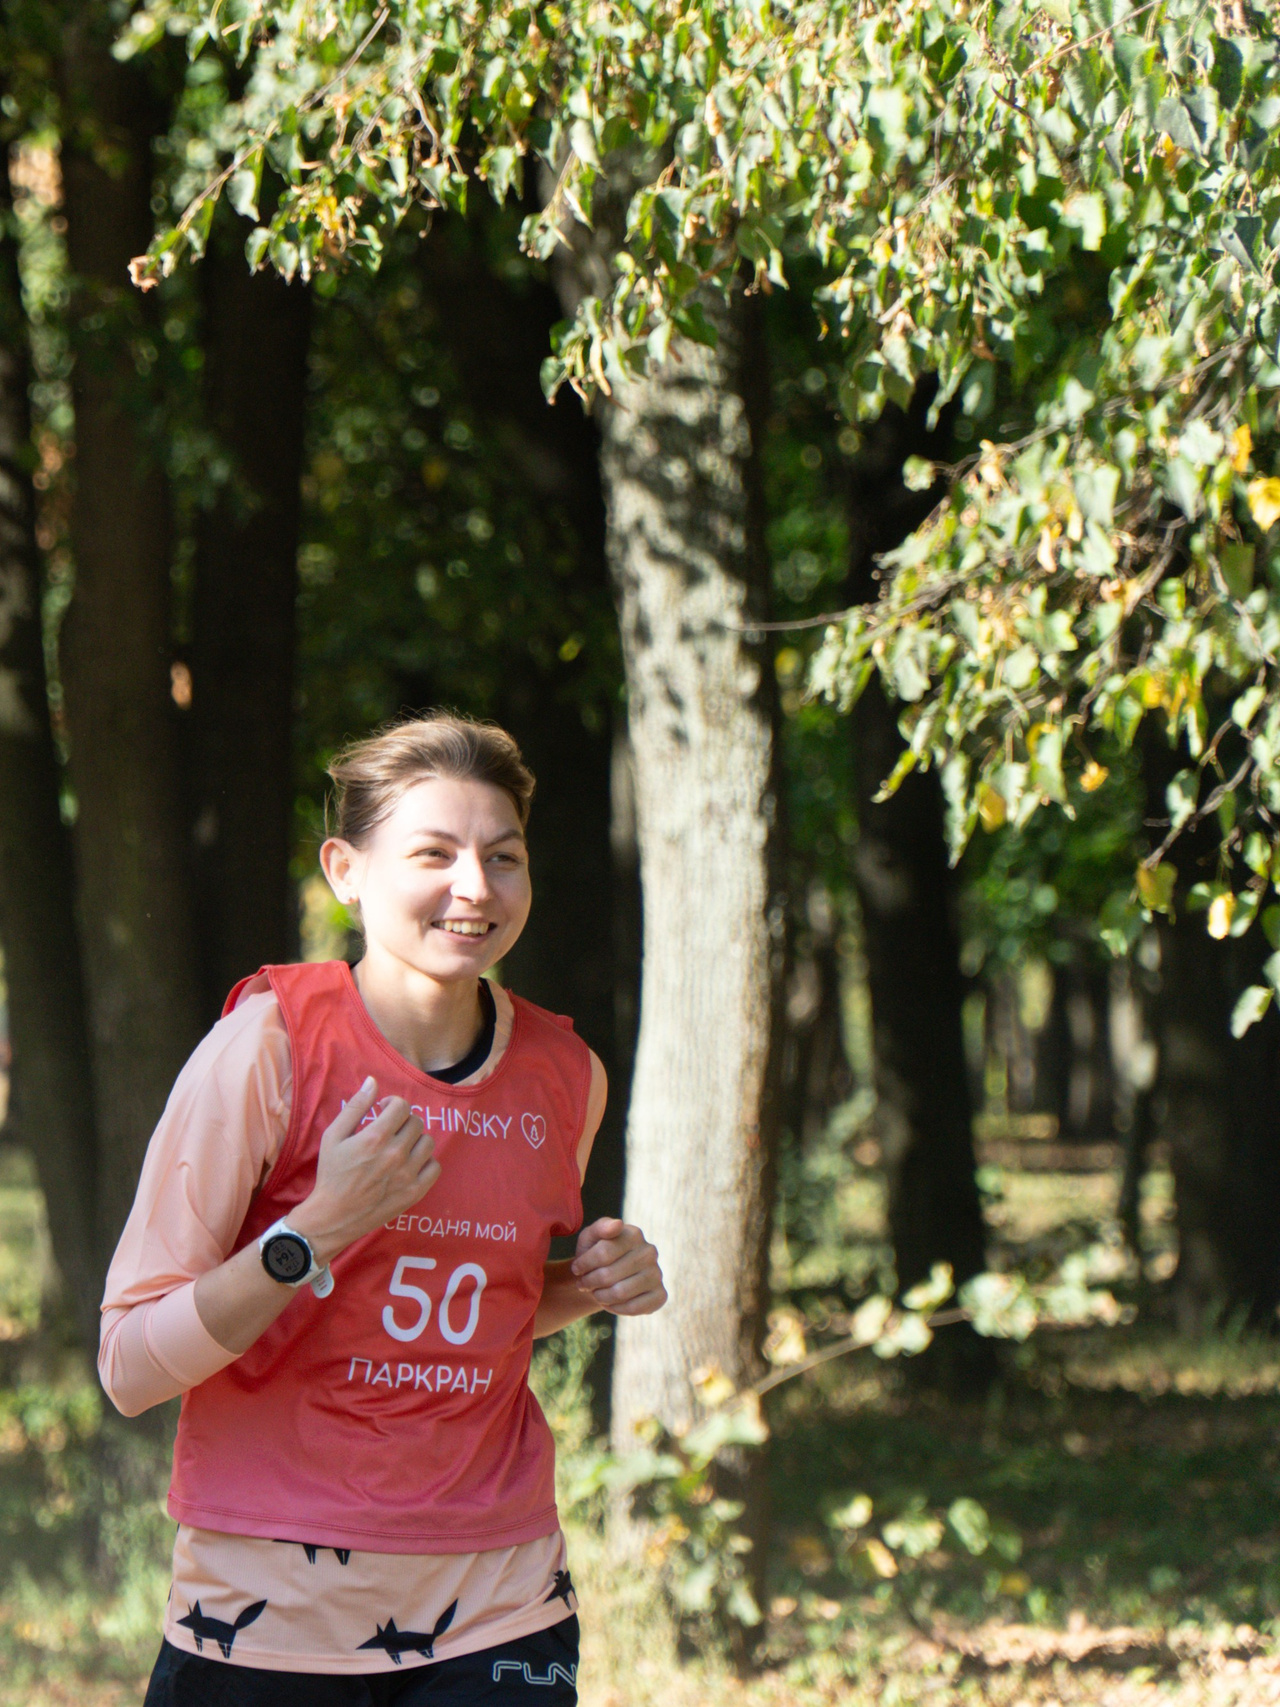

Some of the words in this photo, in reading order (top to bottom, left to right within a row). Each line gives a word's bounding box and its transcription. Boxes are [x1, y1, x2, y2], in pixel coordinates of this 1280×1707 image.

[475, 1221, 517, 1242] МОЙ
[382, 1255, 487, 1345] 50
[348, 1357, 493, 1395] ПАРКРАН
